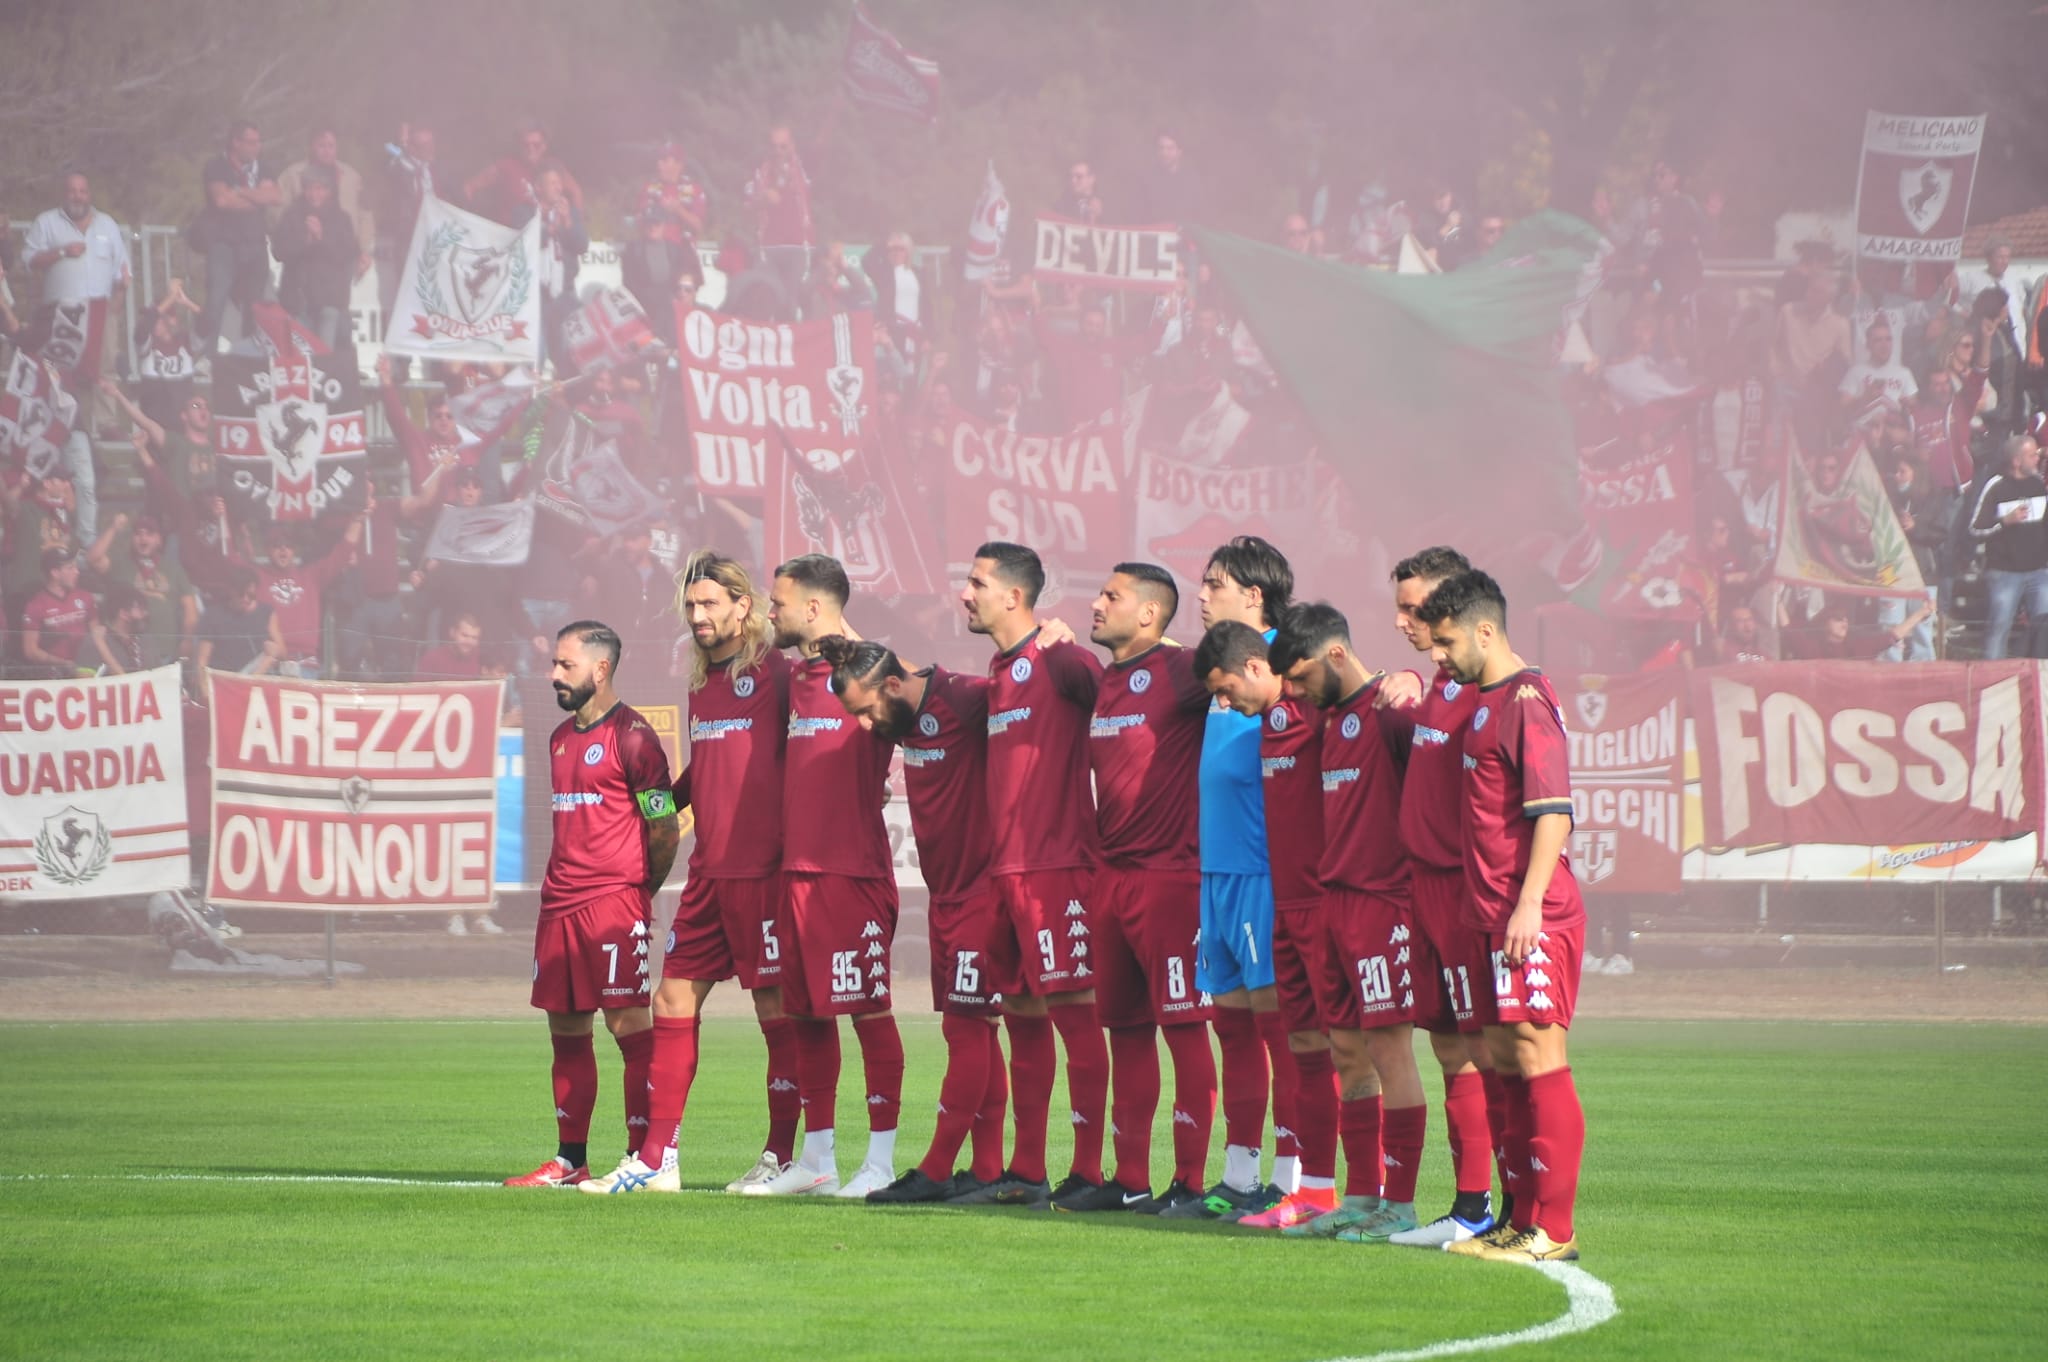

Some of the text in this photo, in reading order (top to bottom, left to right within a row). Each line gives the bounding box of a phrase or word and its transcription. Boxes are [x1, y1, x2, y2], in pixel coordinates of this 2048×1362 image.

[1877, 118, 1979, 138] MELICIANO
[1035, 219, 1179, 281] DEVILS
[1864, 237, 1961, 257] AMARANTO
[684, 309, 795, 371] Ogni
[238, 364, 342, 406] AREZZO
[220, 424, 250, 450] 19
[328, 421, 362, 447] 94
[952, 421, 1119, 493] CURVA
[233, 465, 354, 512] OVUNQUE
[985, 487, 1088, 553] SUD
[239, 685, 473, 769] AREZZO
[1710, 674, 2025, 841] FOSSA
[218, 812, 488, 901] OVUNQUE
[762, 919, 780, 961] 5
[1037, 929, 1056, 971] 9
[1244, 922, 1258, 964] 1
[602, 943, 618, 984] 7
[832, 950, 862, 993] 95
[955, 950, 979, 993] 15
[1167, 956, 1185, 999] 8
[1358, 954, 1392, 1003] 20
